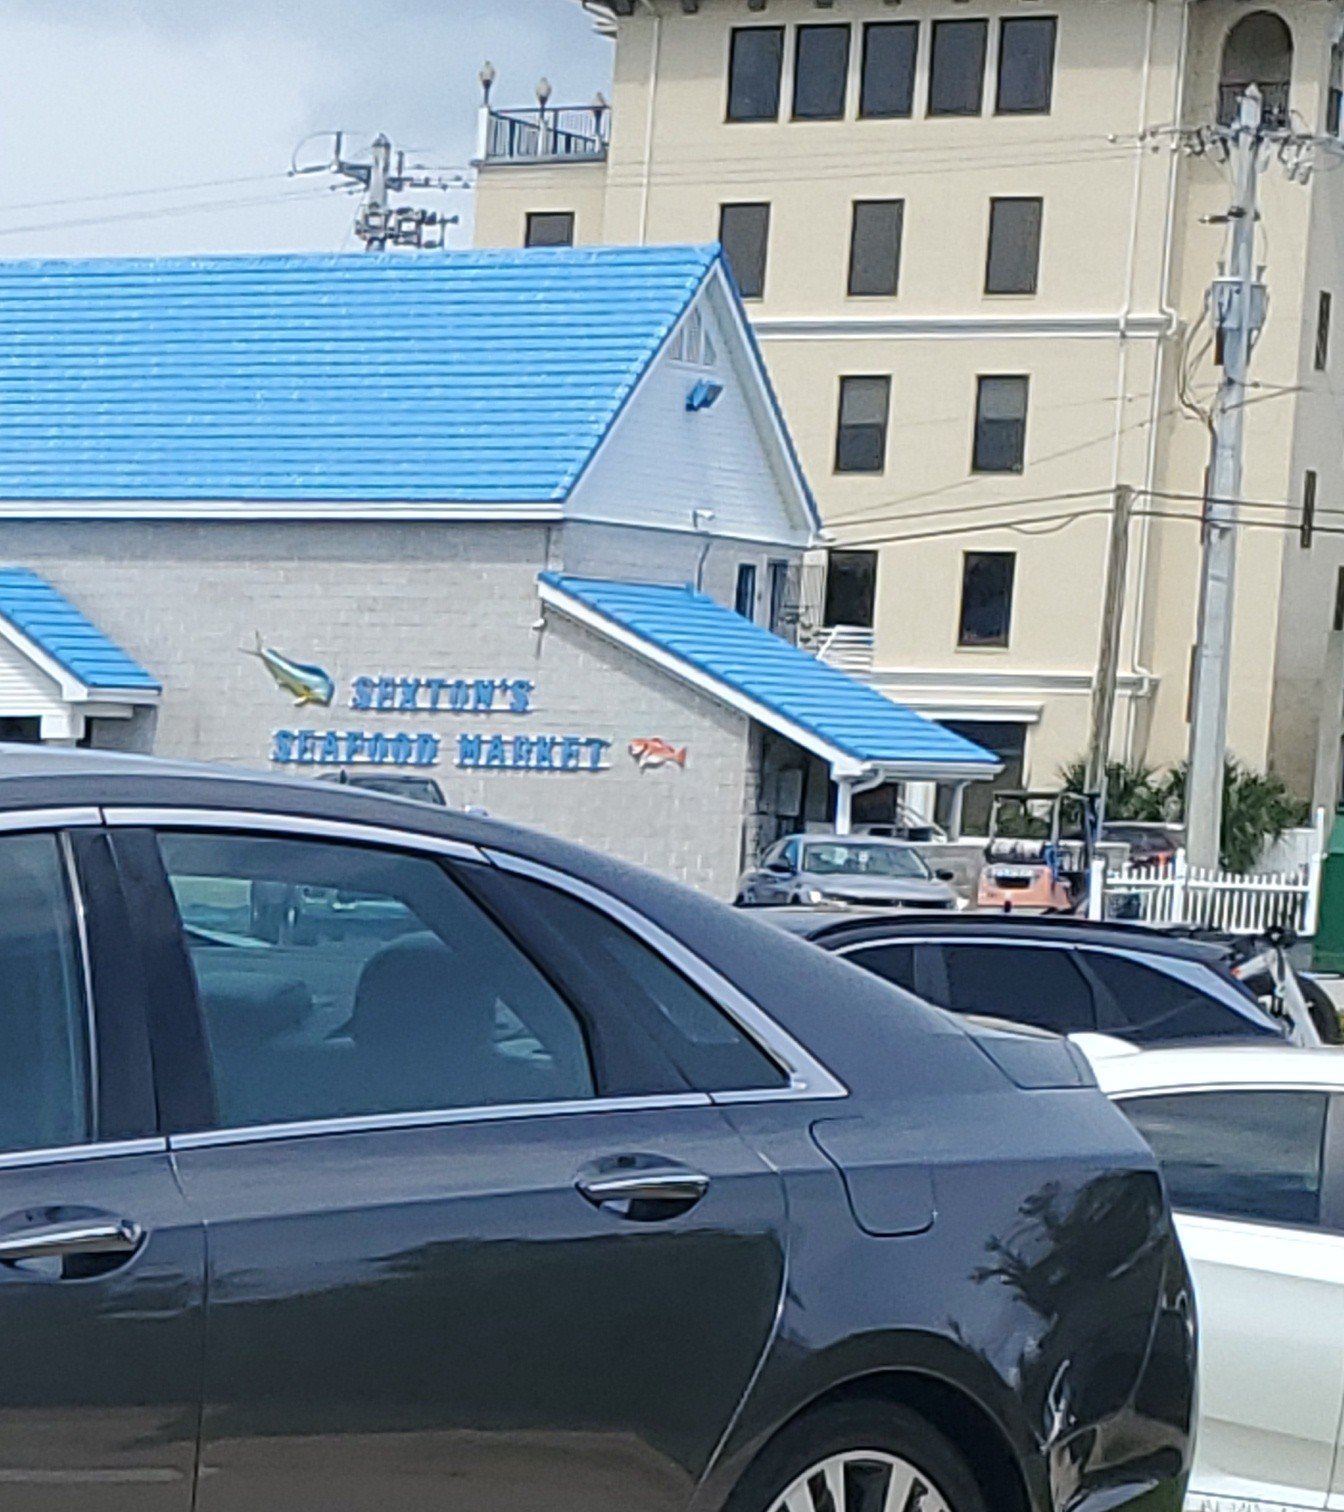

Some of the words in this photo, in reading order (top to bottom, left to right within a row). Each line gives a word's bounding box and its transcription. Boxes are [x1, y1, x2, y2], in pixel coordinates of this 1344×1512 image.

[349, 676, 534, 713] SEXTON'S
[269, 729, 441, 766] SEAFOOD
[455, 732, 612, 769] MARKET
